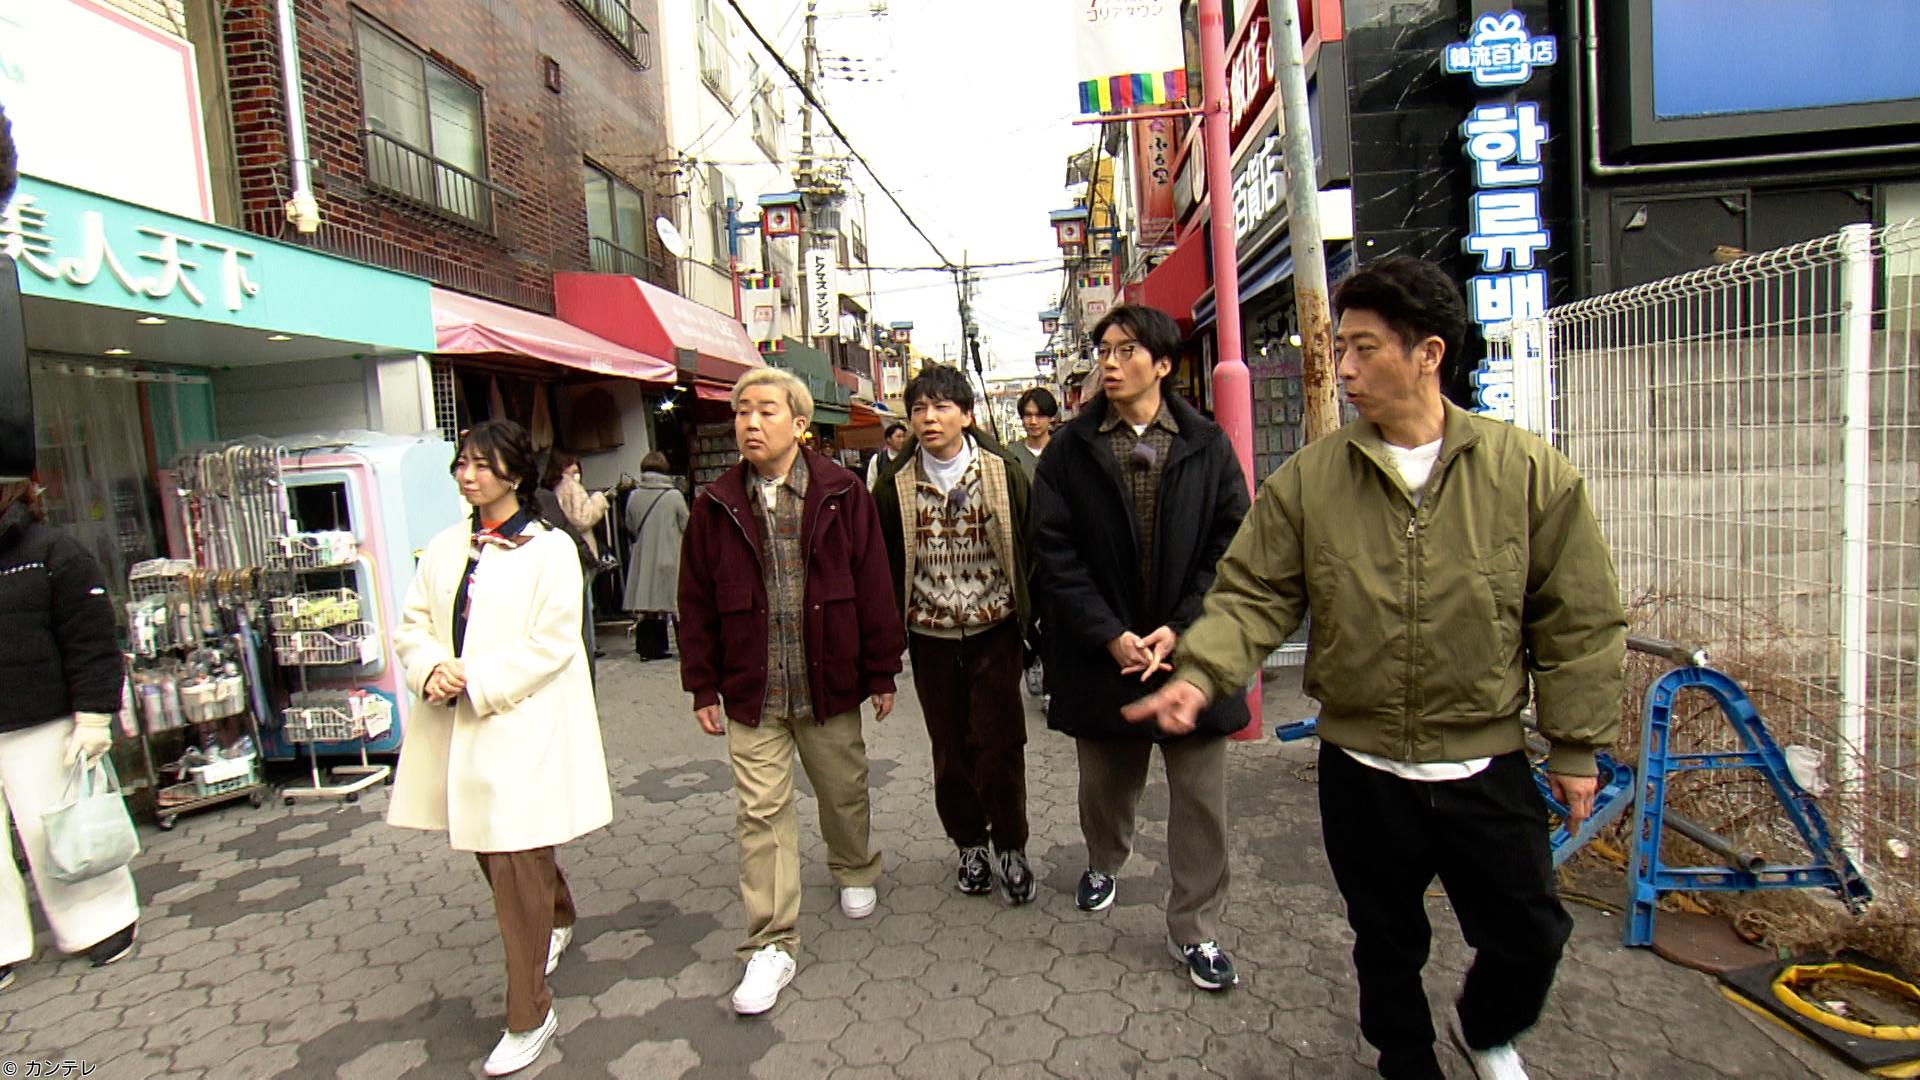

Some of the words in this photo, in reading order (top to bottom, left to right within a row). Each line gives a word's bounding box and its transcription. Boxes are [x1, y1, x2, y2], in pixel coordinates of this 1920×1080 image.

[1449, 40, 1553, 68] 韓流百貨店
[0, 194, 258, 311] 美人天下
